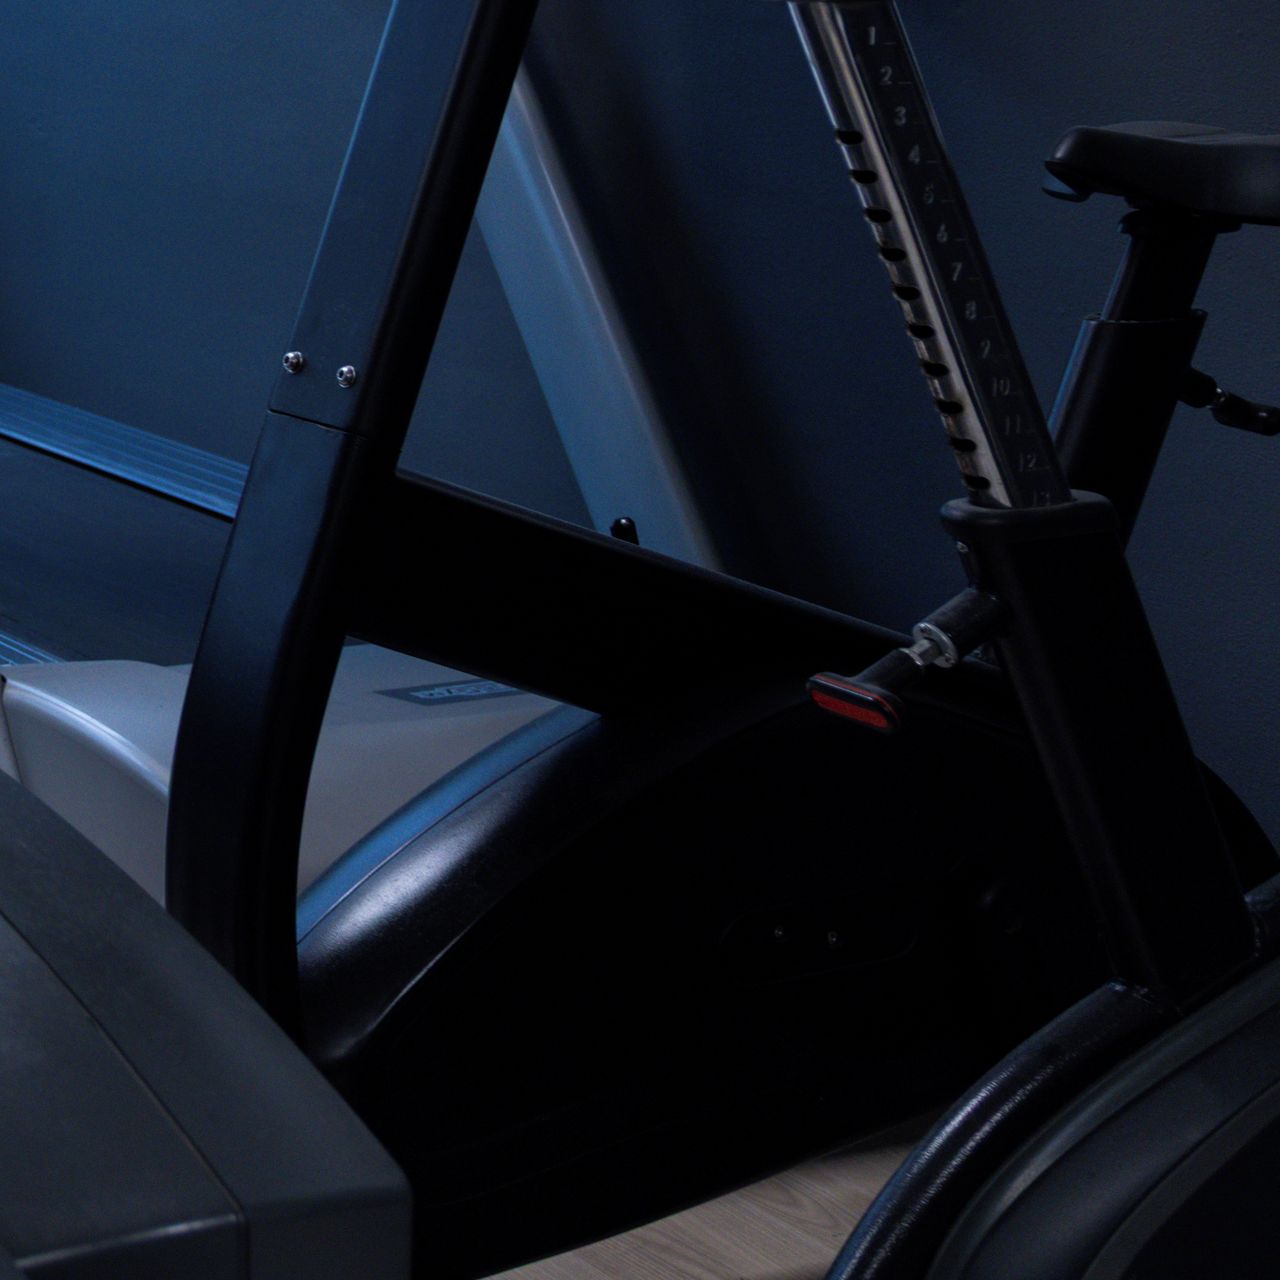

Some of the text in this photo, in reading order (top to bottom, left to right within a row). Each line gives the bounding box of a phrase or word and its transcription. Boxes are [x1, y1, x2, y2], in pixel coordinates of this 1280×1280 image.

[867, 25, 876, 47] 1
[880, 65, 893, 86] 2
[894, 105, 907, 127] 3
[907, 144, 921, 165] 4
[923, 183, 935, 204] 5
[936, 223, 948, 244] 6
[952, 262, 963, 282] 7
[965, 299, 977, 320] 8
[978, 338, 991, 359] 9
[991, 376, 1010, 397] 10
[1004, 414, 1021, 436] 11
[1017, 450, 1037, 472] 12
